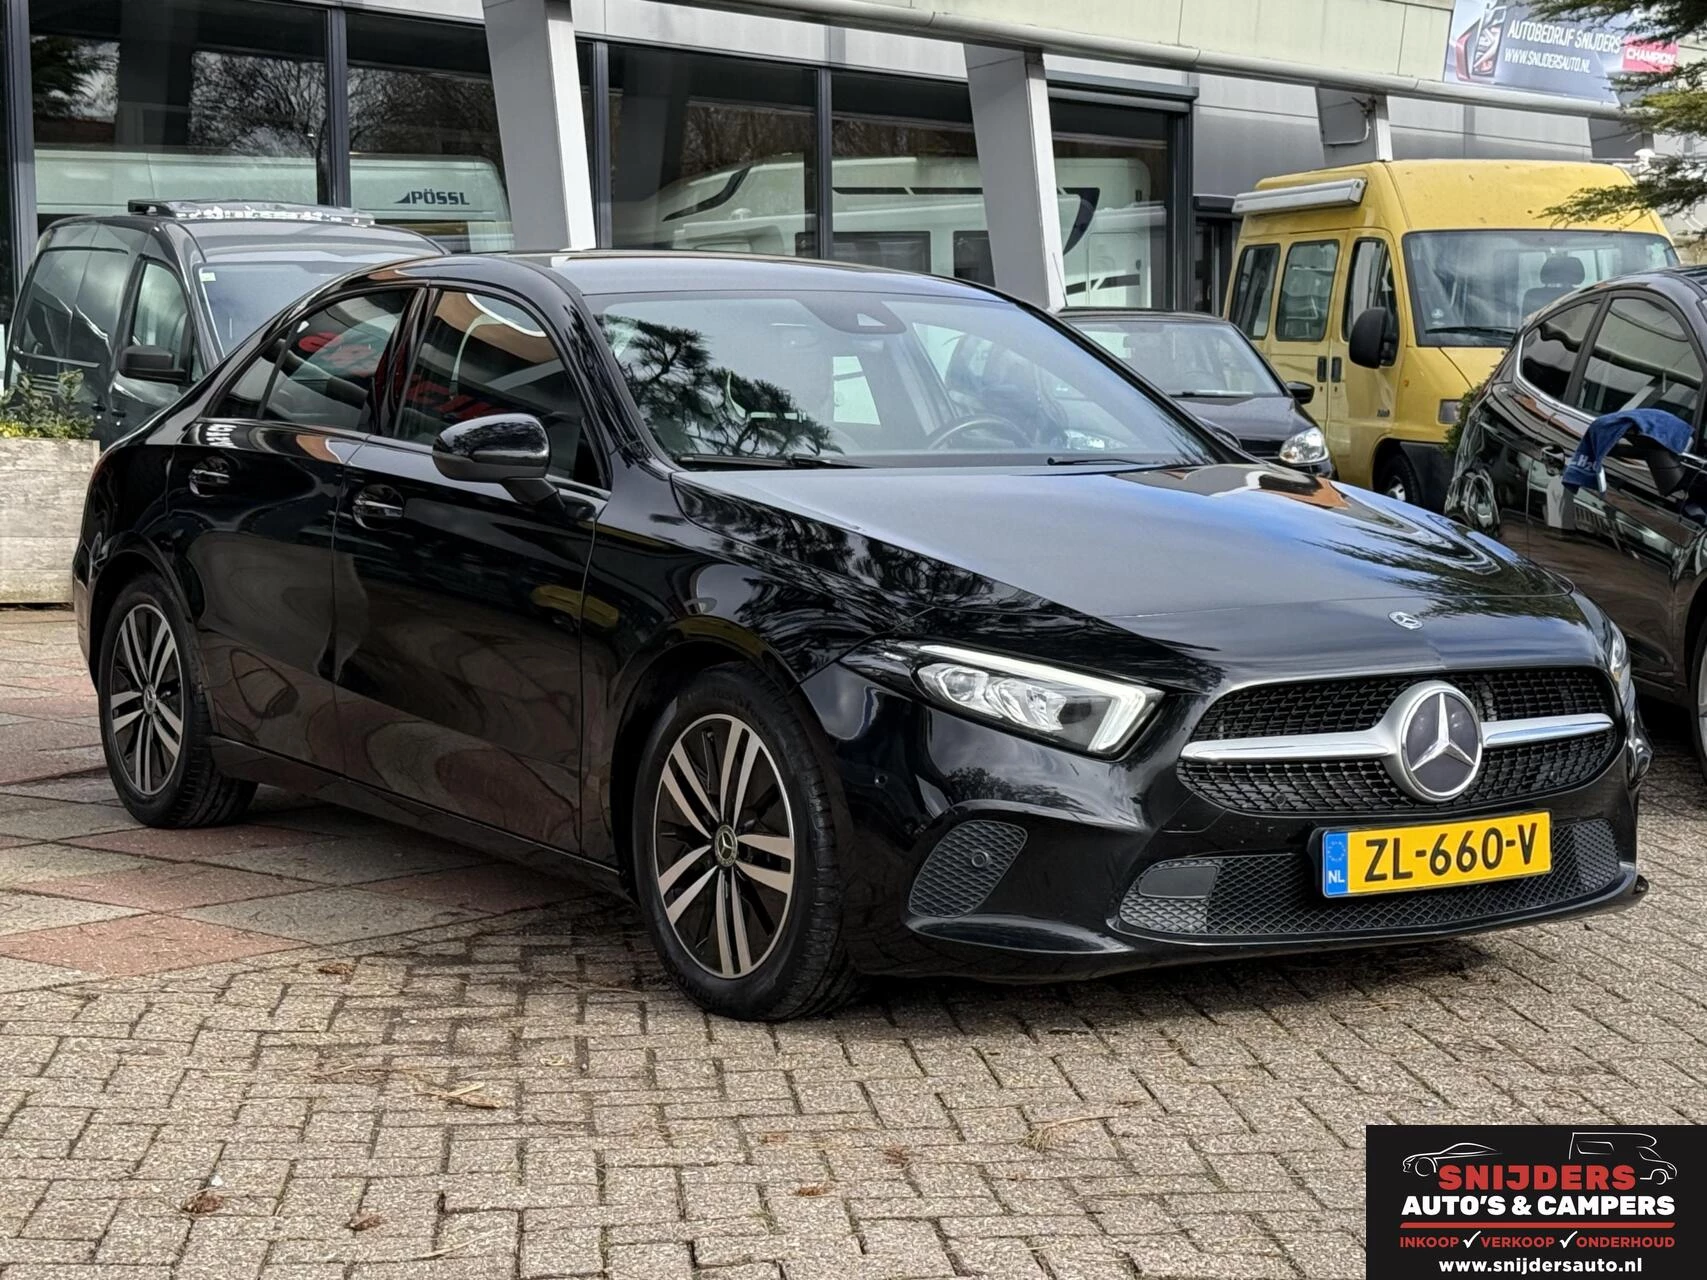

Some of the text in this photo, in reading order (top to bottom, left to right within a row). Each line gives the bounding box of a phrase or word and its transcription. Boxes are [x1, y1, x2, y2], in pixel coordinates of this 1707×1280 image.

[1507, 19, 1621, 54] AUTOBEDRIJF SNIJDERS
[1504, 47, 1591, 74] WWW.SNIJDERSAUTO.NL
[410, 188, 470, 206] PÖSSL
[1364, 822, 1538, 882] ZL-660-V
[1328, 870, 1345, 884] NL
